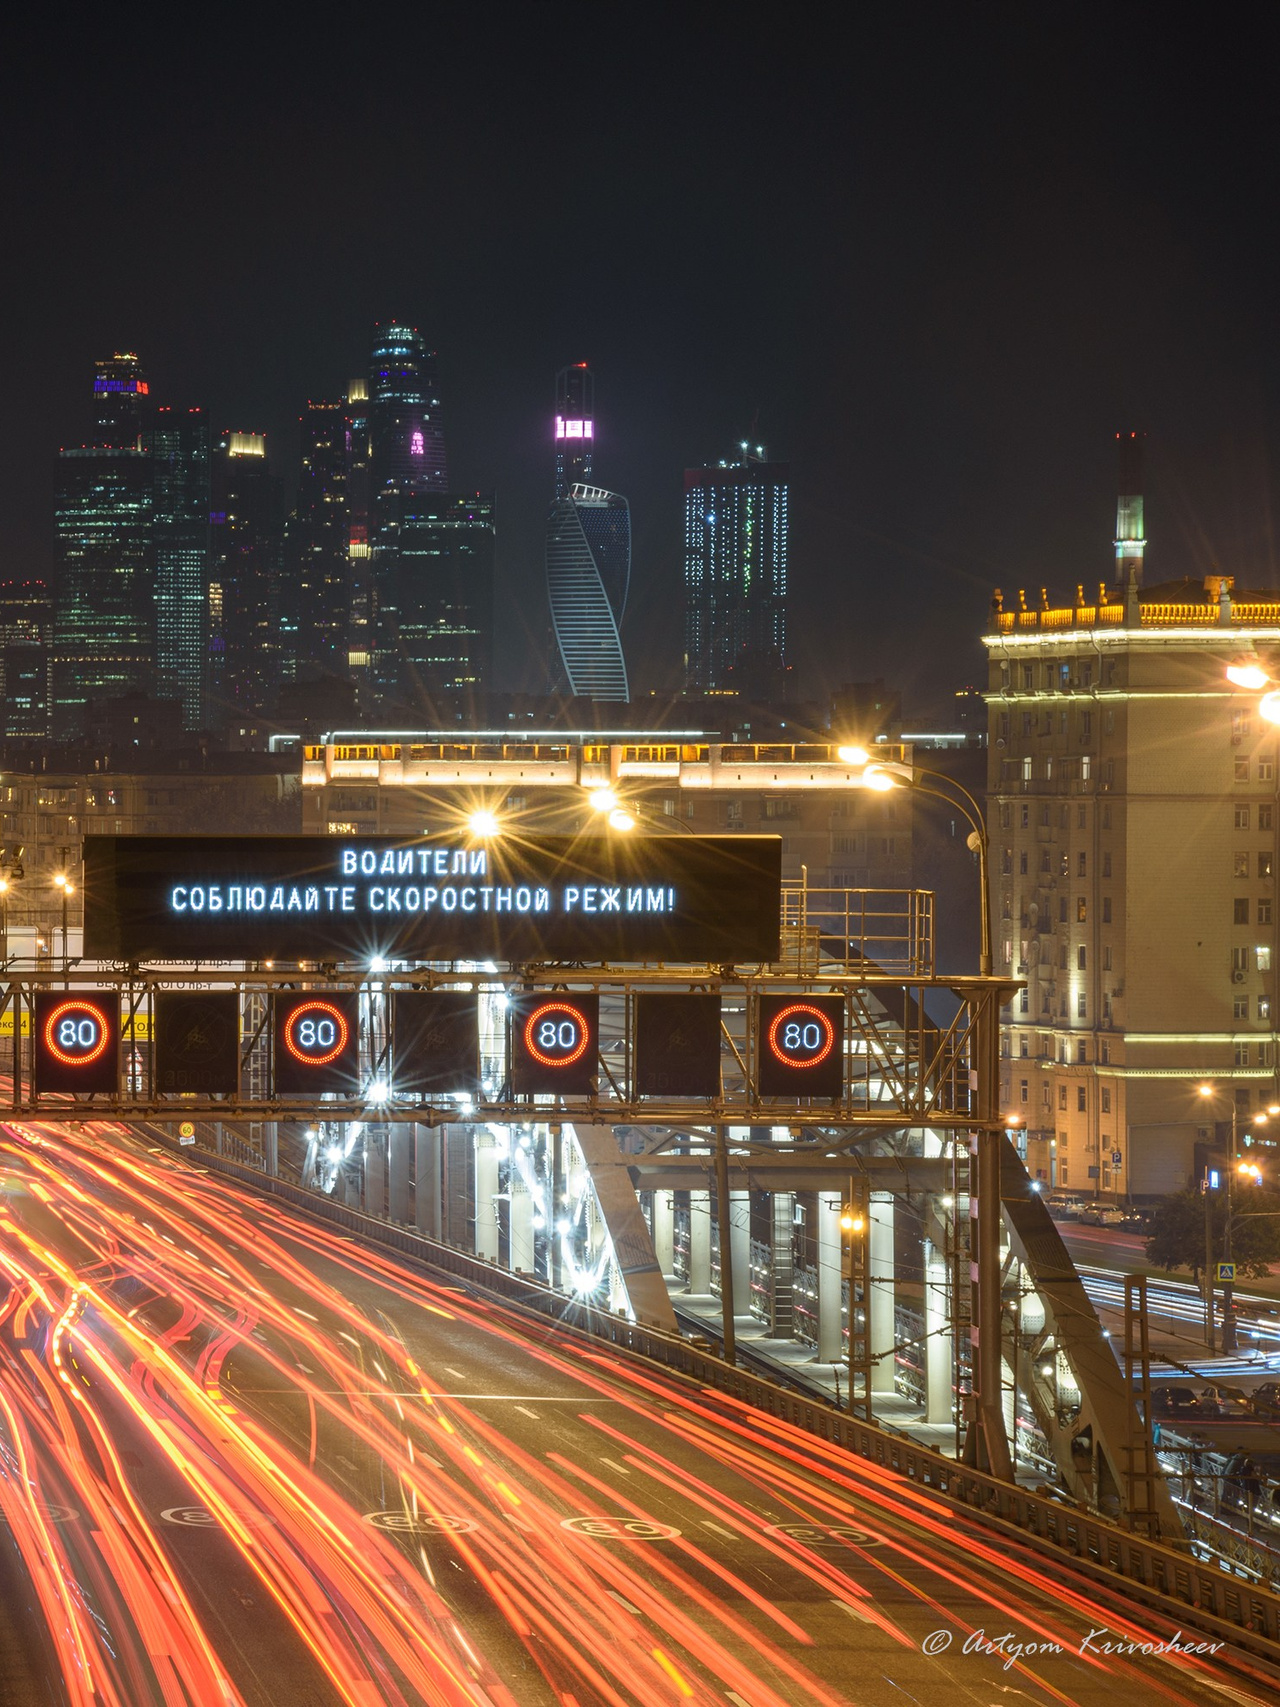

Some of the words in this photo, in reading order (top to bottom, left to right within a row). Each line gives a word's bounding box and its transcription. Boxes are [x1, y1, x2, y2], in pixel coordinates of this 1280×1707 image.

[343, 850, 487, 875] ВОДИТЕЛИ
[172, 887, 356, 911] СОБЛЮДАЙТЕ
[369, 887, 550, 911] СКОРОСТНОЙ
[564, 887, 676, 911] РЕЖИМ!
[60, 1020, 95, 1046] 80
[300, 1020, 335, 1046] 80
[540, 1022, 575, 1048] 80
[784, 1023, 820, 1049] 80
[581, 1521, 660, 1535] 80
